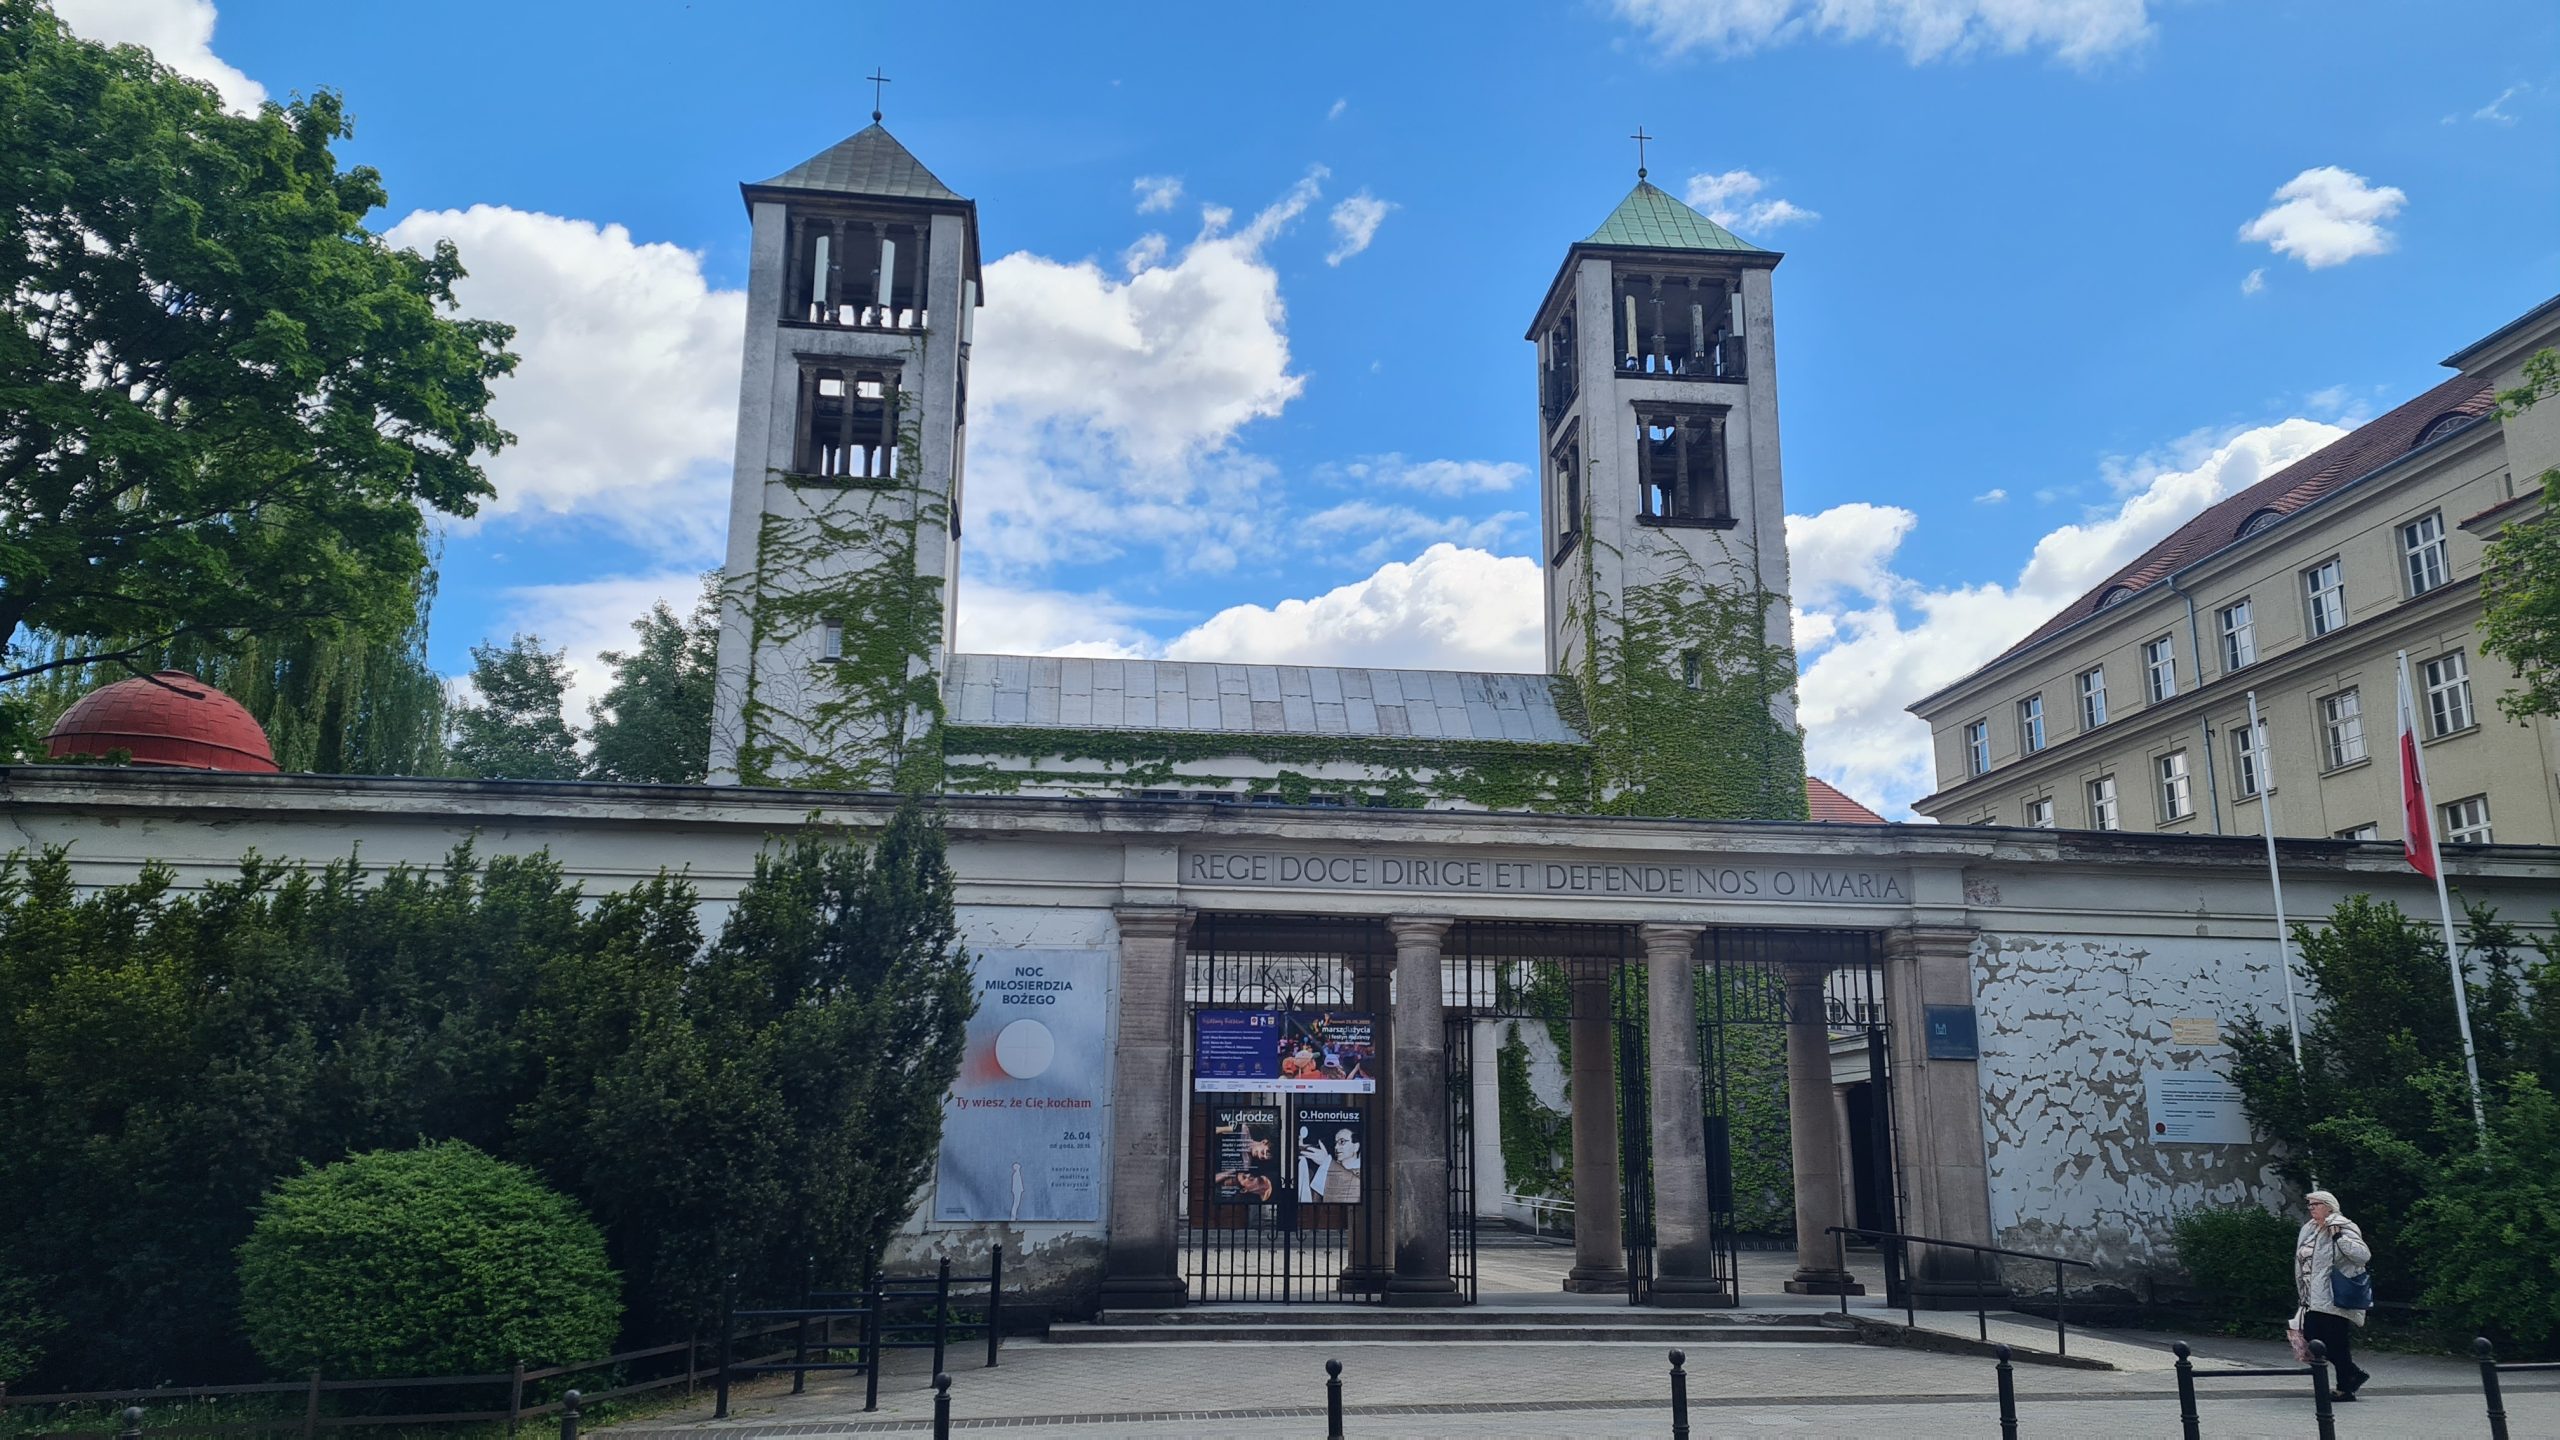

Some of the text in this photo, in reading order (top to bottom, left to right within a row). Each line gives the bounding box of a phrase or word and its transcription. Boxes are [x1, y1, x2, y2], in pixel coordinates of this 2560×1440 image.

[1190, 854, 1905, 899] REGE DOCE DIRIGE ET DEFENDE NOS O MARIA
[1015, 966, 1044, 977] NOC
[985, 979, 1073, 991] MIŁOSIERDZIA
[1002, 992, 1056, 1005] BOŻEGO
[955, 1096, 1092, 1111] Ty wiesz, że Cię kocham
[1235, 1110, 1274, 1122] drodze
